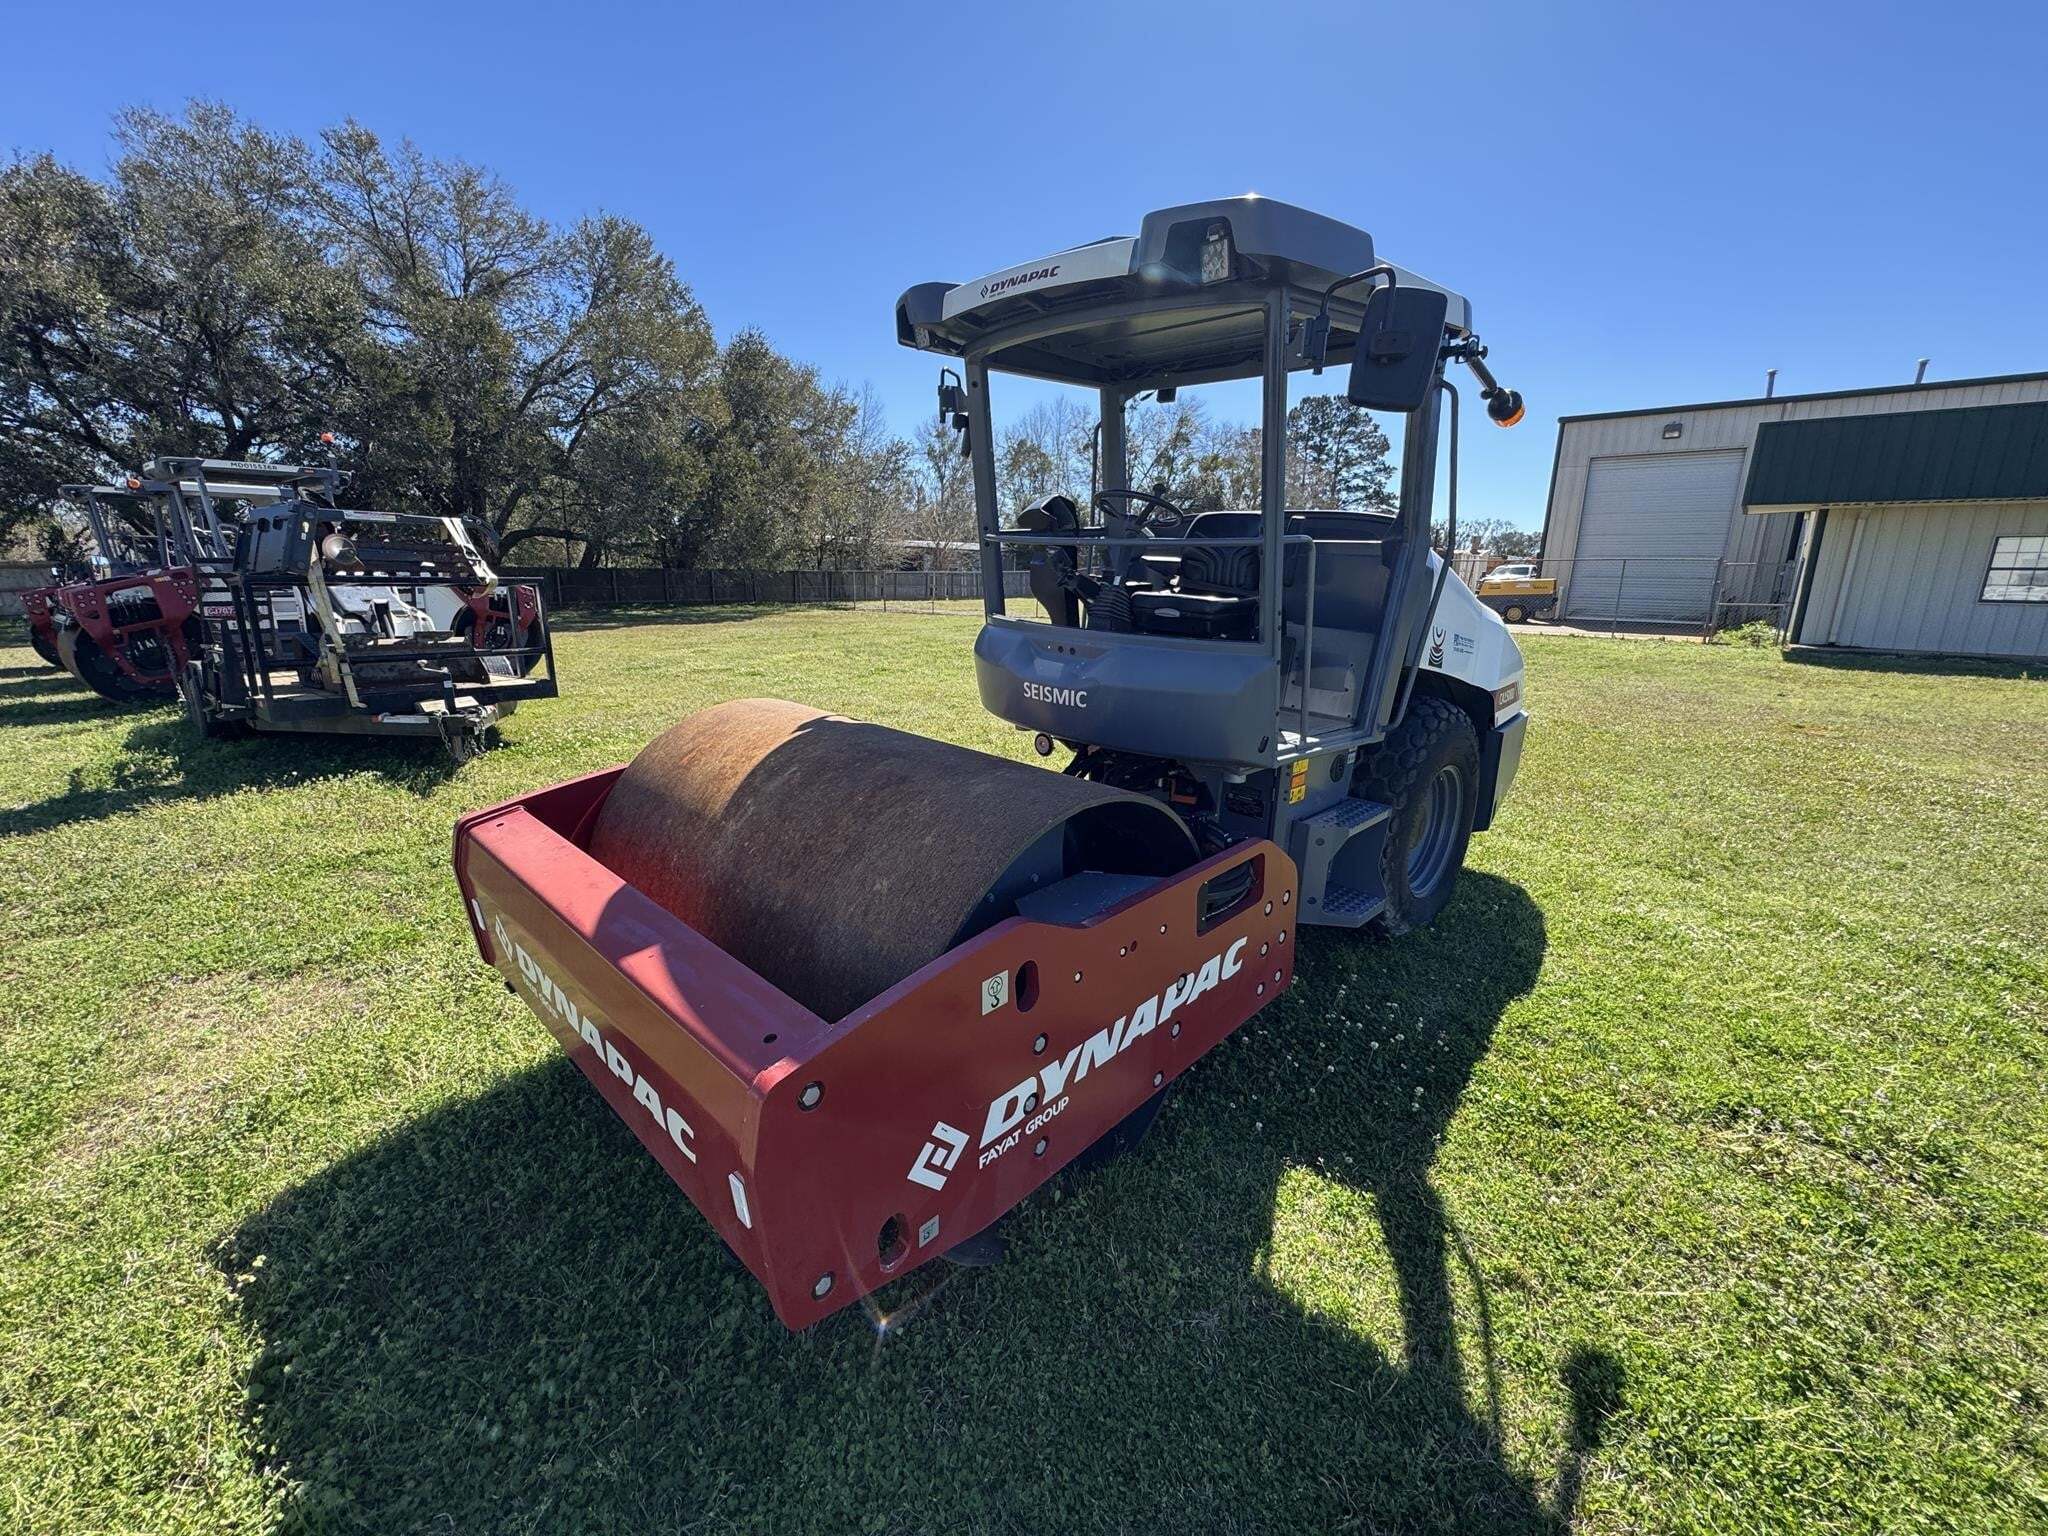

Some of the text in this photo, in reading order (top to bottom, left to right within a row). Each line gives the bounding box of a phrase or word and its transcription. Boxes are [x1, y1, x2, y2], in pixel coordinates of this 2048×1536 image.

[989, 265, 1061, 294] DYNAPAC
[1023, 681, 1087, 708] SEISMIC
[515, 942, 696, 1164] DYNAPAC
[979, 936, 1248, 1149] DYNAPAC
[979, 1096, 1069, 1170] FAYAT GROUP
